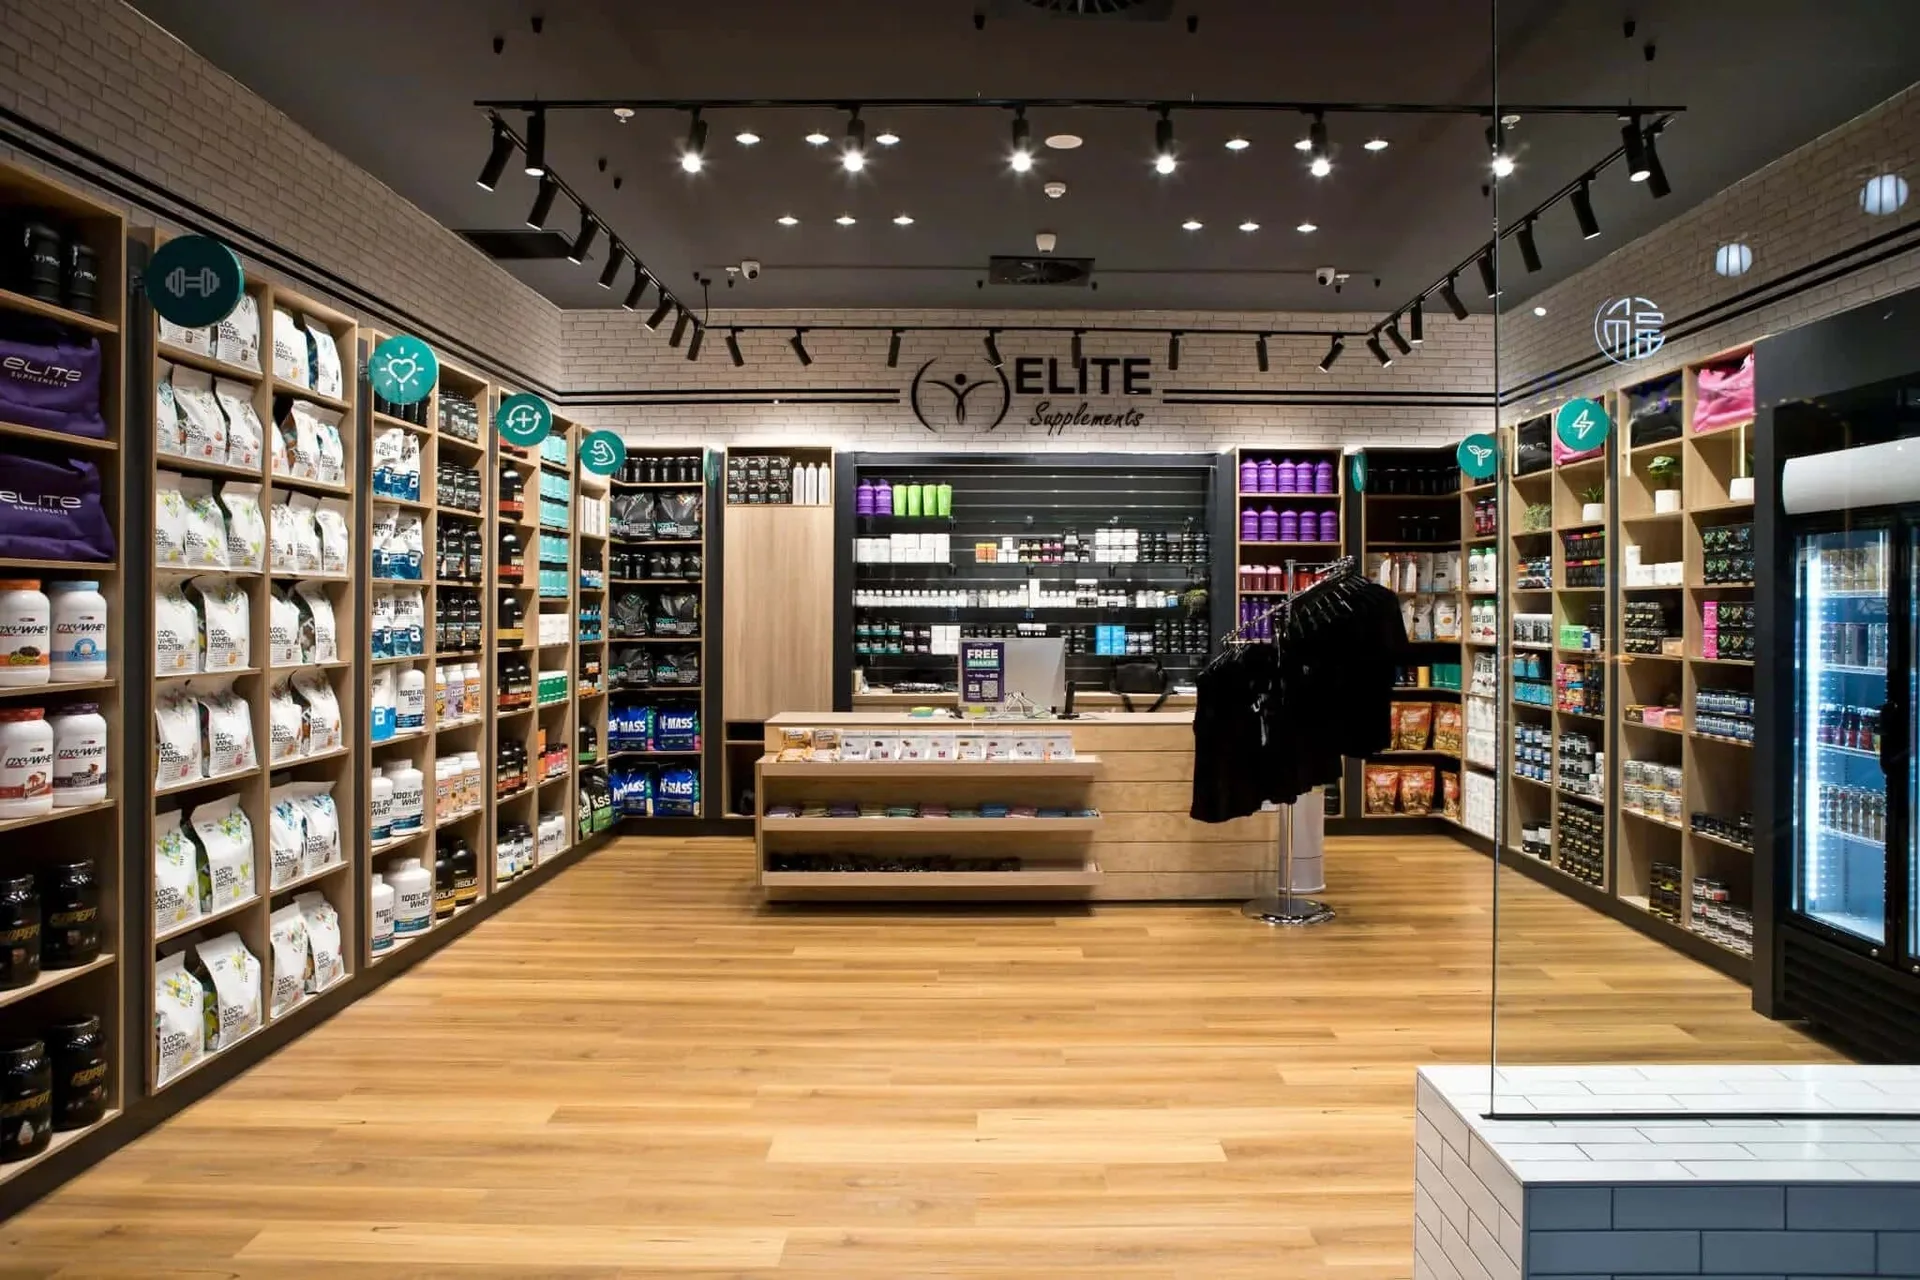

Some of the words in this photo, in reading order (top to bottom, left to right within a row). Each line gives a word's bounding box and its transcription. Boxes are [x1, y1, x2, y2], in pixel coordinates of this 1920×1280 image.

[1015, 358, 1151, 394] ELITE
[1029, 401, 1145, 435] Supplements
[967, 649, 998, 659] FREE
[393, 791, 412, 800] 100%
[457, 878, 477, 888] ISOLAT
[401, 893, 420, 902] 100%
[435, 889, 454, 899] SOLAT
